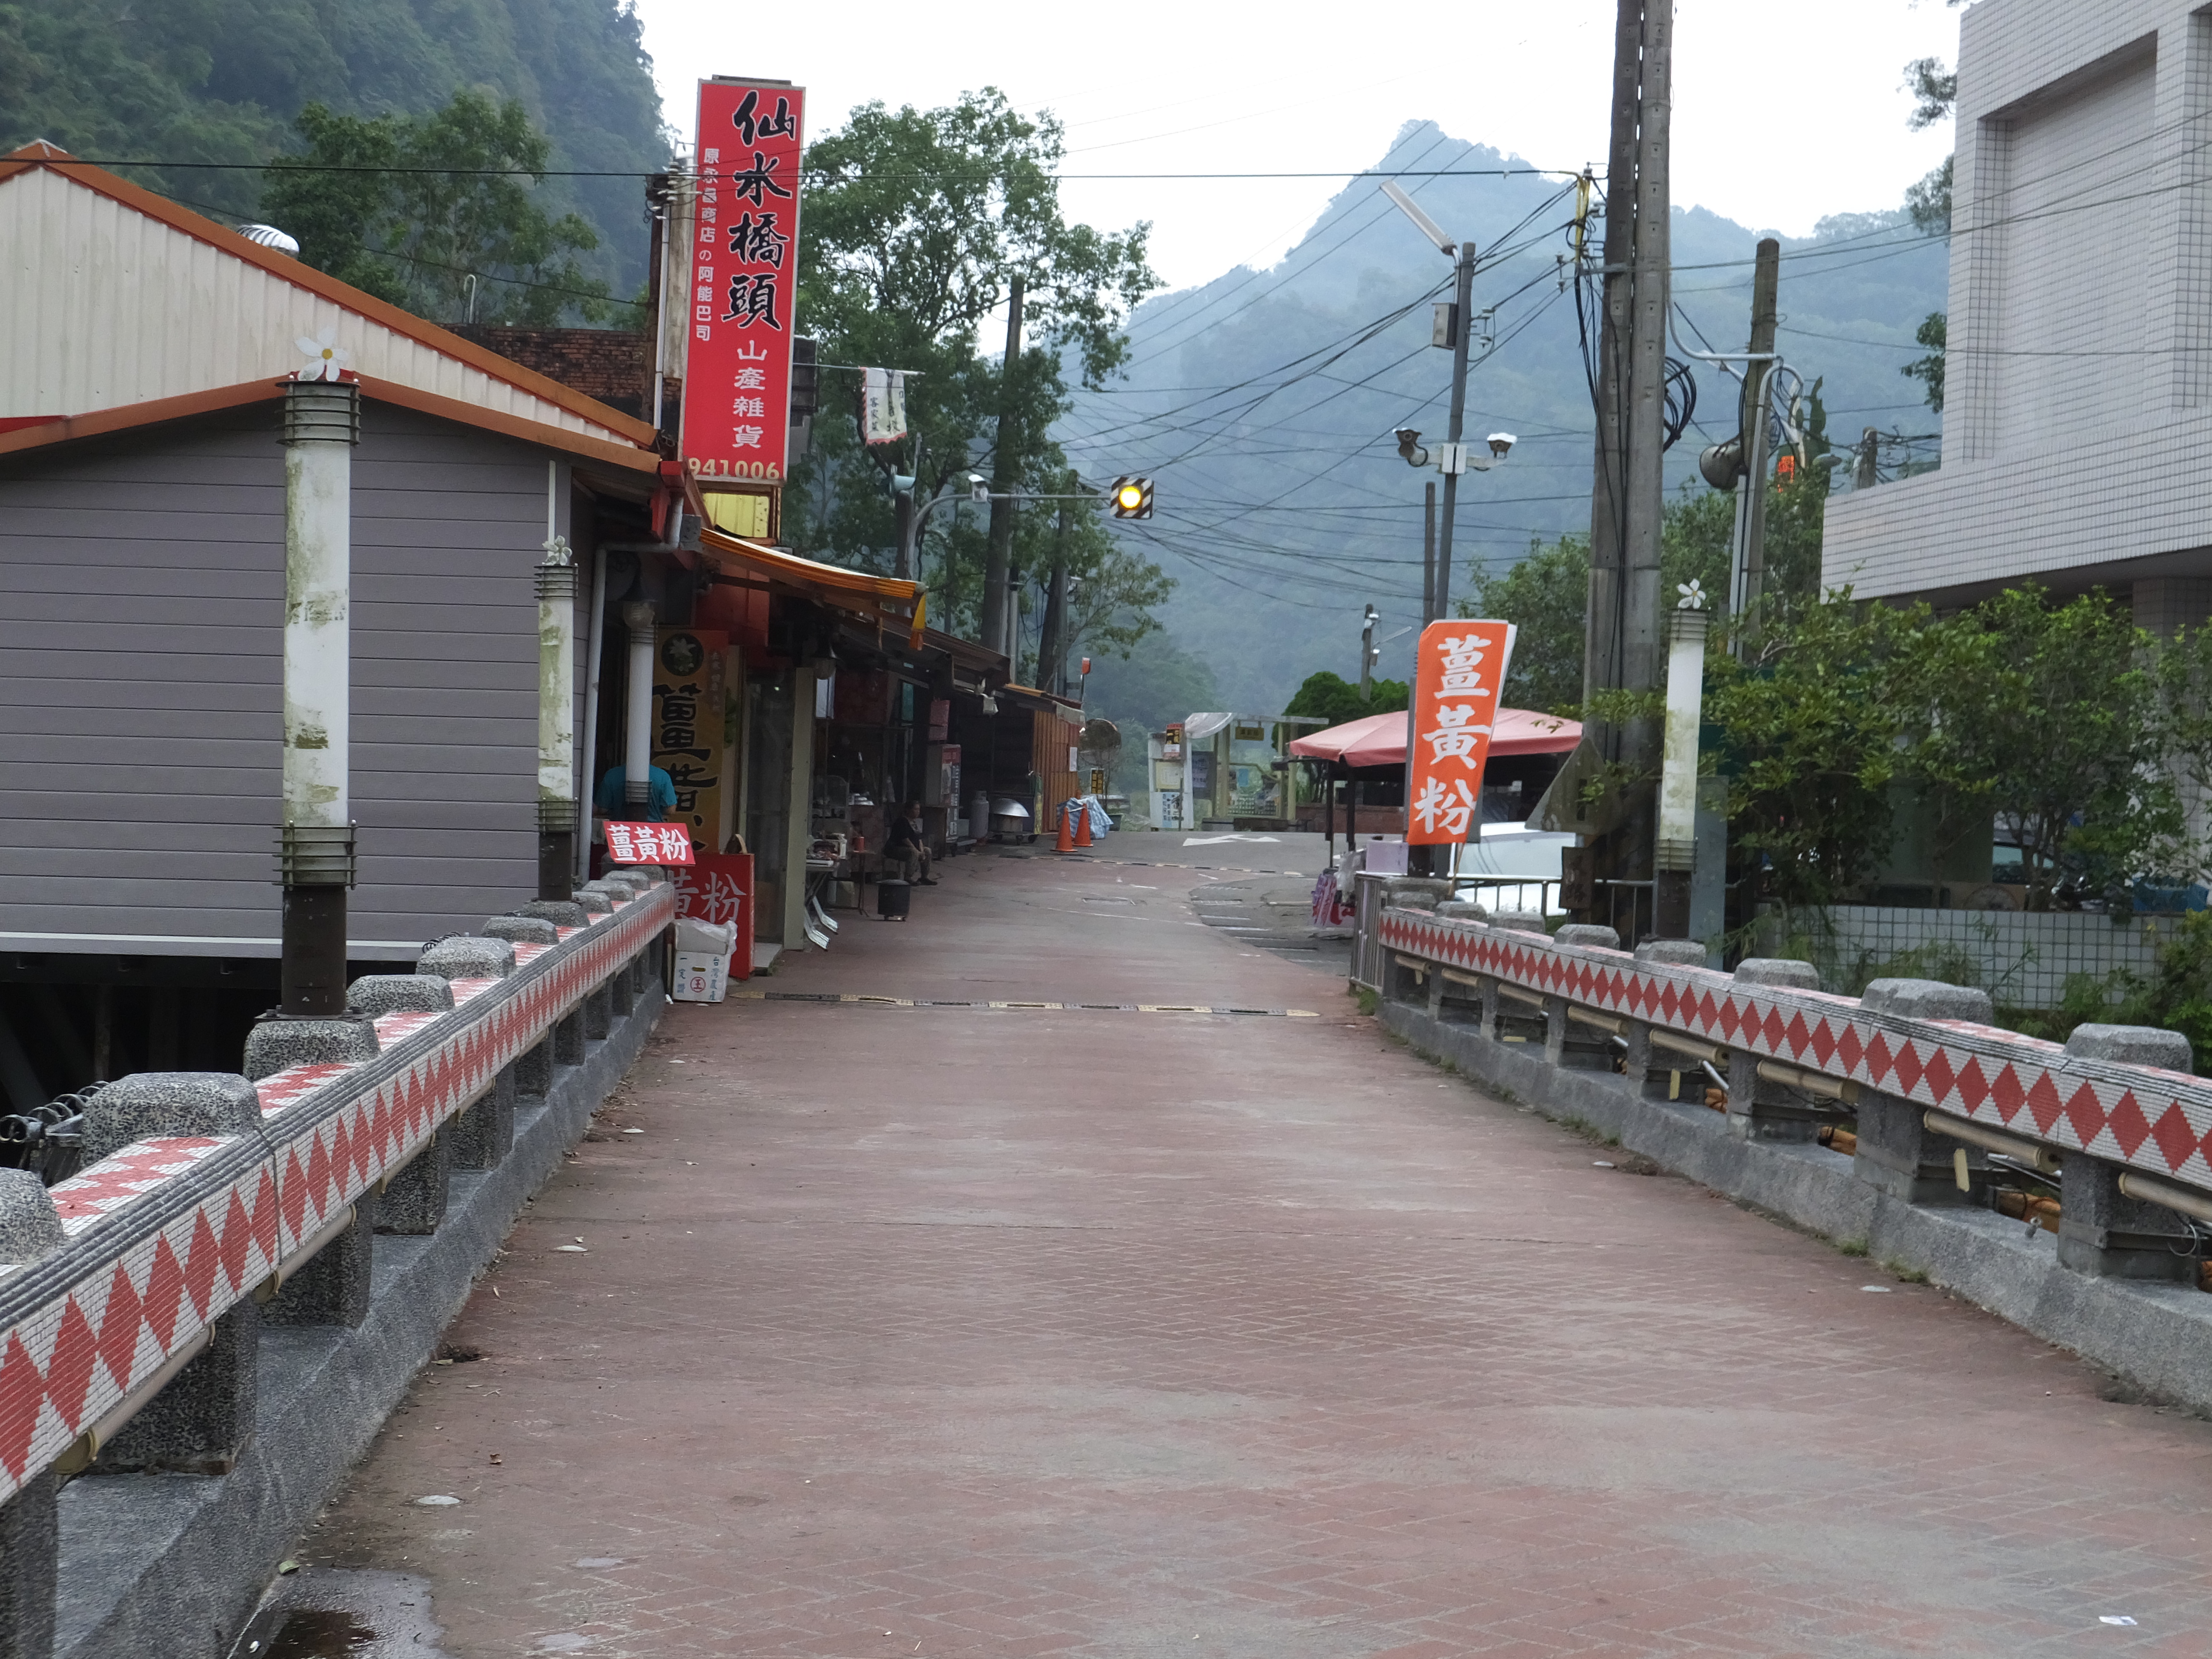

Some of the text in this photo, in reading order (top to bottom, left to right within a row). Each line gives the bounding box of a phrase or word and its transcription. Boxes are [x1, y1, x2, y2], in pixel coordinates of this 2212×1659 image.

[721, 90, 797, 331] 仙水橋頭
[733, 340, 768, 448] 山產雜貨
[688, 457, 780, 480] 941006
[1414, 634, 1492, 835] 薑黃粉
[607, 824, 689, 862] 薑黃粉
